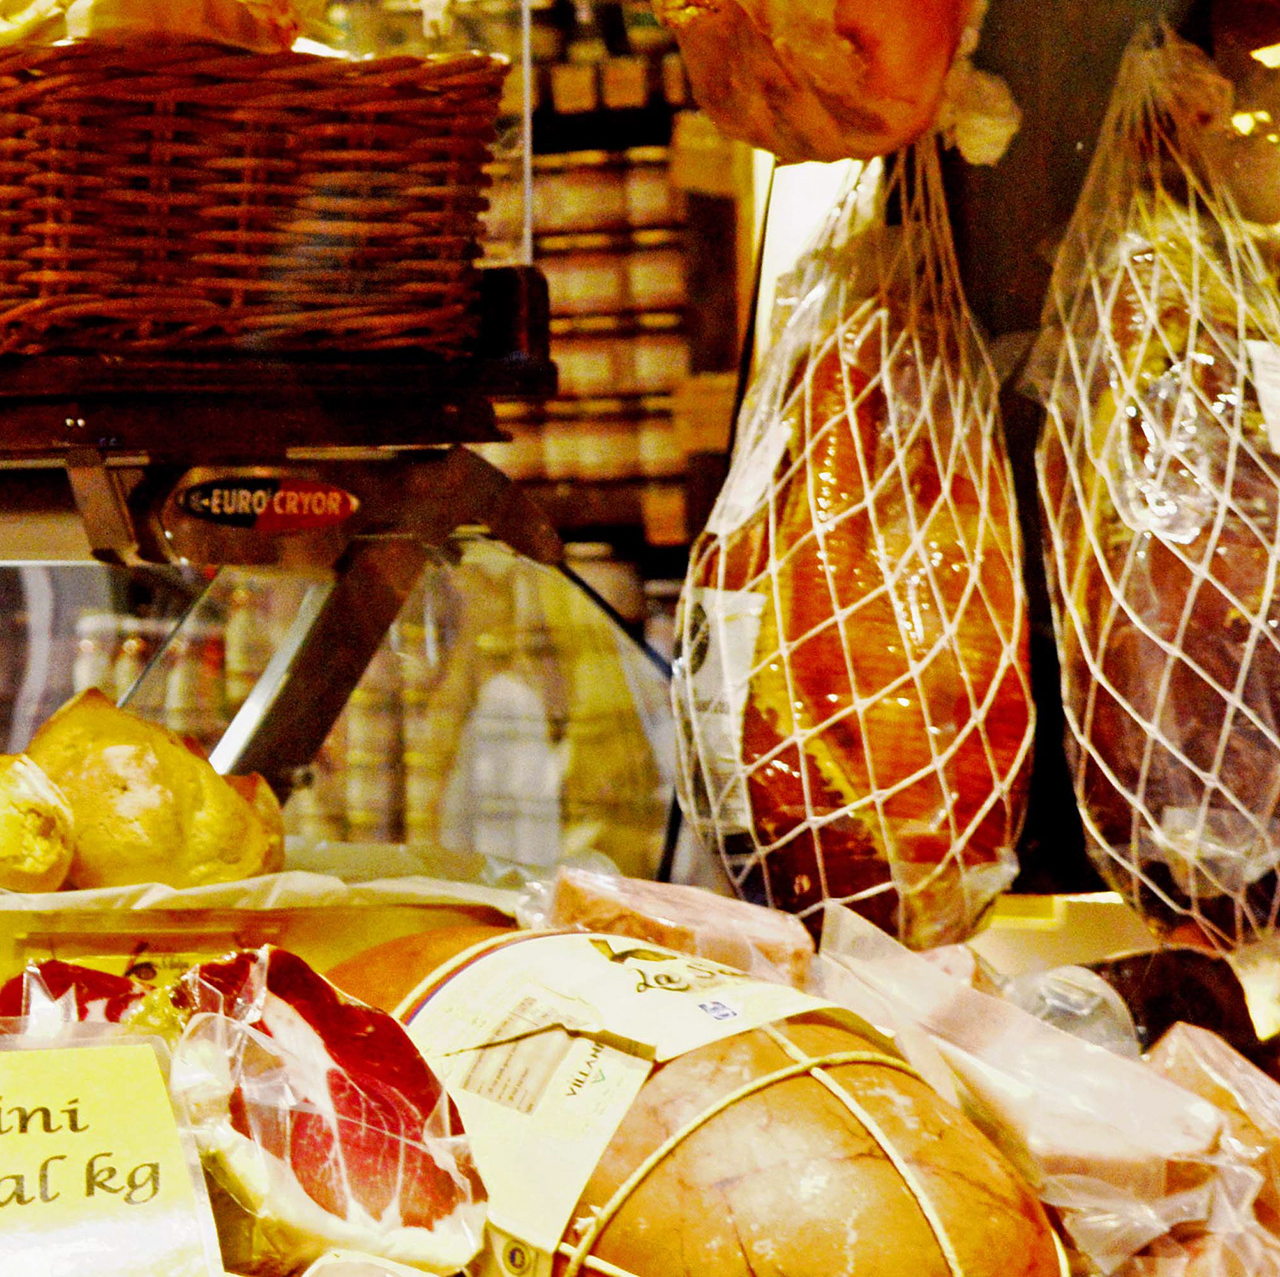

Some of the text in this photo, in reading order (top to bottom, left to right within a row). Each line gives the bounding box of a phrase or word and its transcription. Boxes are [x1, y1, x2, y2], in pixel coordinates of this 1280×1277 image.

[211, 489, 341, 515] EURO CRYOR
[85, 1152, 161, 1206] kg
